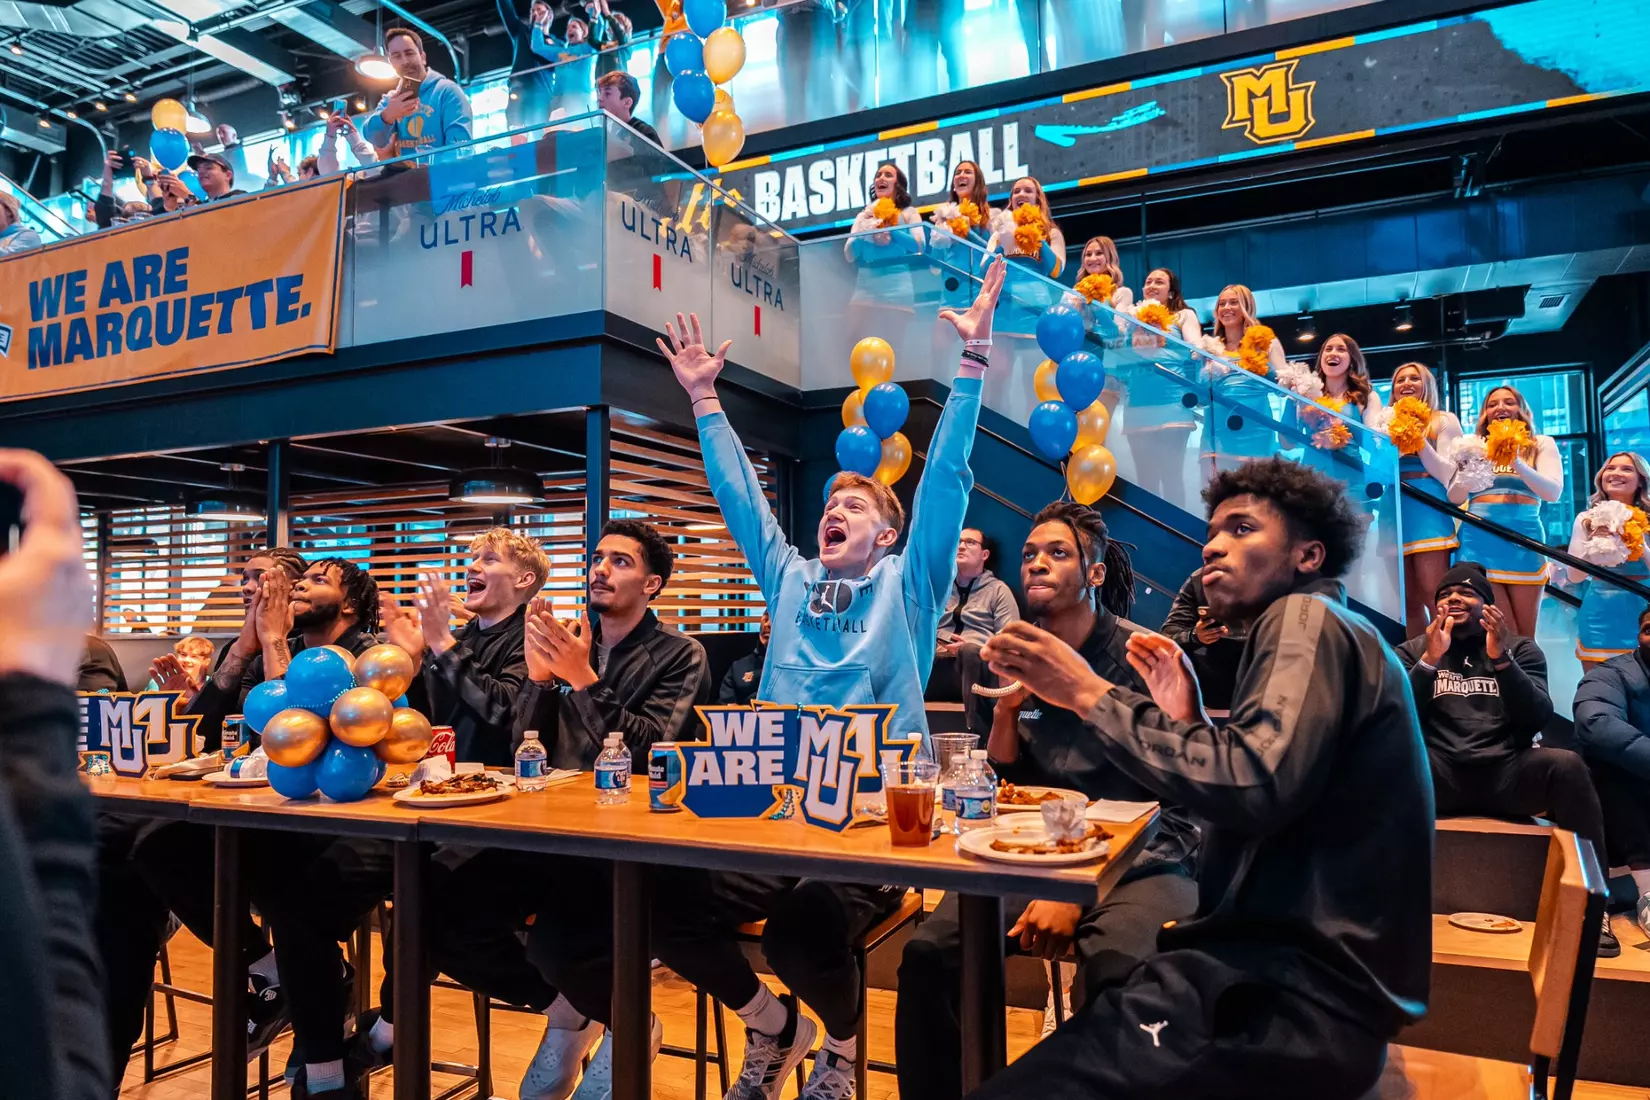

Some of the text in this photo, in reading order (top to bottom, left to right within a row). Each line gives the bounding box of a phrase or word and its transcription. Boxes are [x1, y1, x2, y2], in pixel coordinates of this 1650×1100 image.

[1225, 63, 1312, 141] MU
[434, 185, 502, 216] Michelob
[754, 121, 1029, 225] BASKETBALL
[420, 207, 521, 249] ULTRA
[622, 201, 692, 263] ULTRA
[28, 246, 190, 322] WE ARE
[731, 262, 784, 311] ULTRA
[28, 273, 312, 370] MARQUETTE.
[99, 700, 144, 772] MU
[707, 712, 785, 746] WE
[688, 750, 785, 785] ARE
[793, 716, 854, 823] MU
